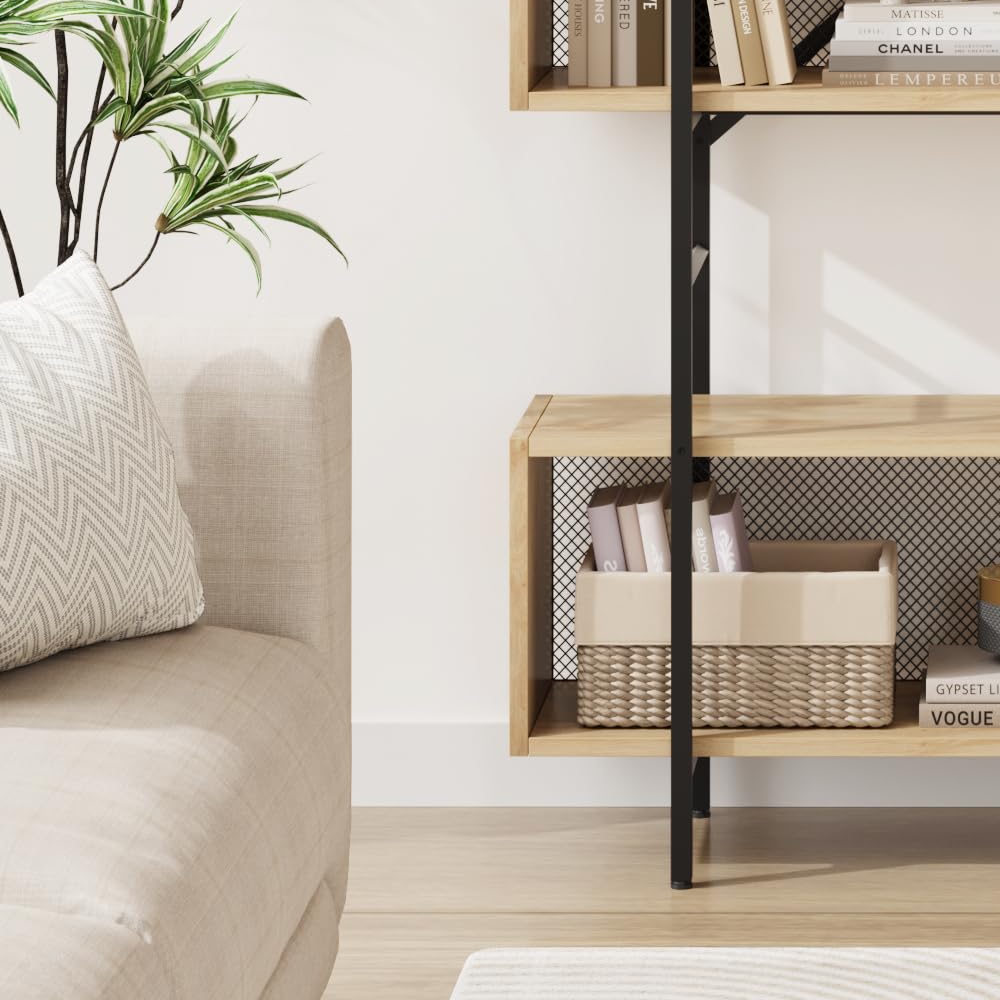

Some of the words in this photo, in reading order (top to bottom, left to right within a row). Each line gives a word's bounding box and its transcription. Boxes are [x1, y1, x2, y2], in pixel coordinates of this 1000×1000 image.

[574, 2, 583, 37] HOUSES
[737, 4, 752, 35] DESIGN
[890, 9, 945, 19] MATISSE
[896, 26, 974, 36] LONDON
[878, 43, 944, 54] CHANEL
[936, 684, 984, 695] GYPSET
[931, 711, 994, 726] VOGUE
